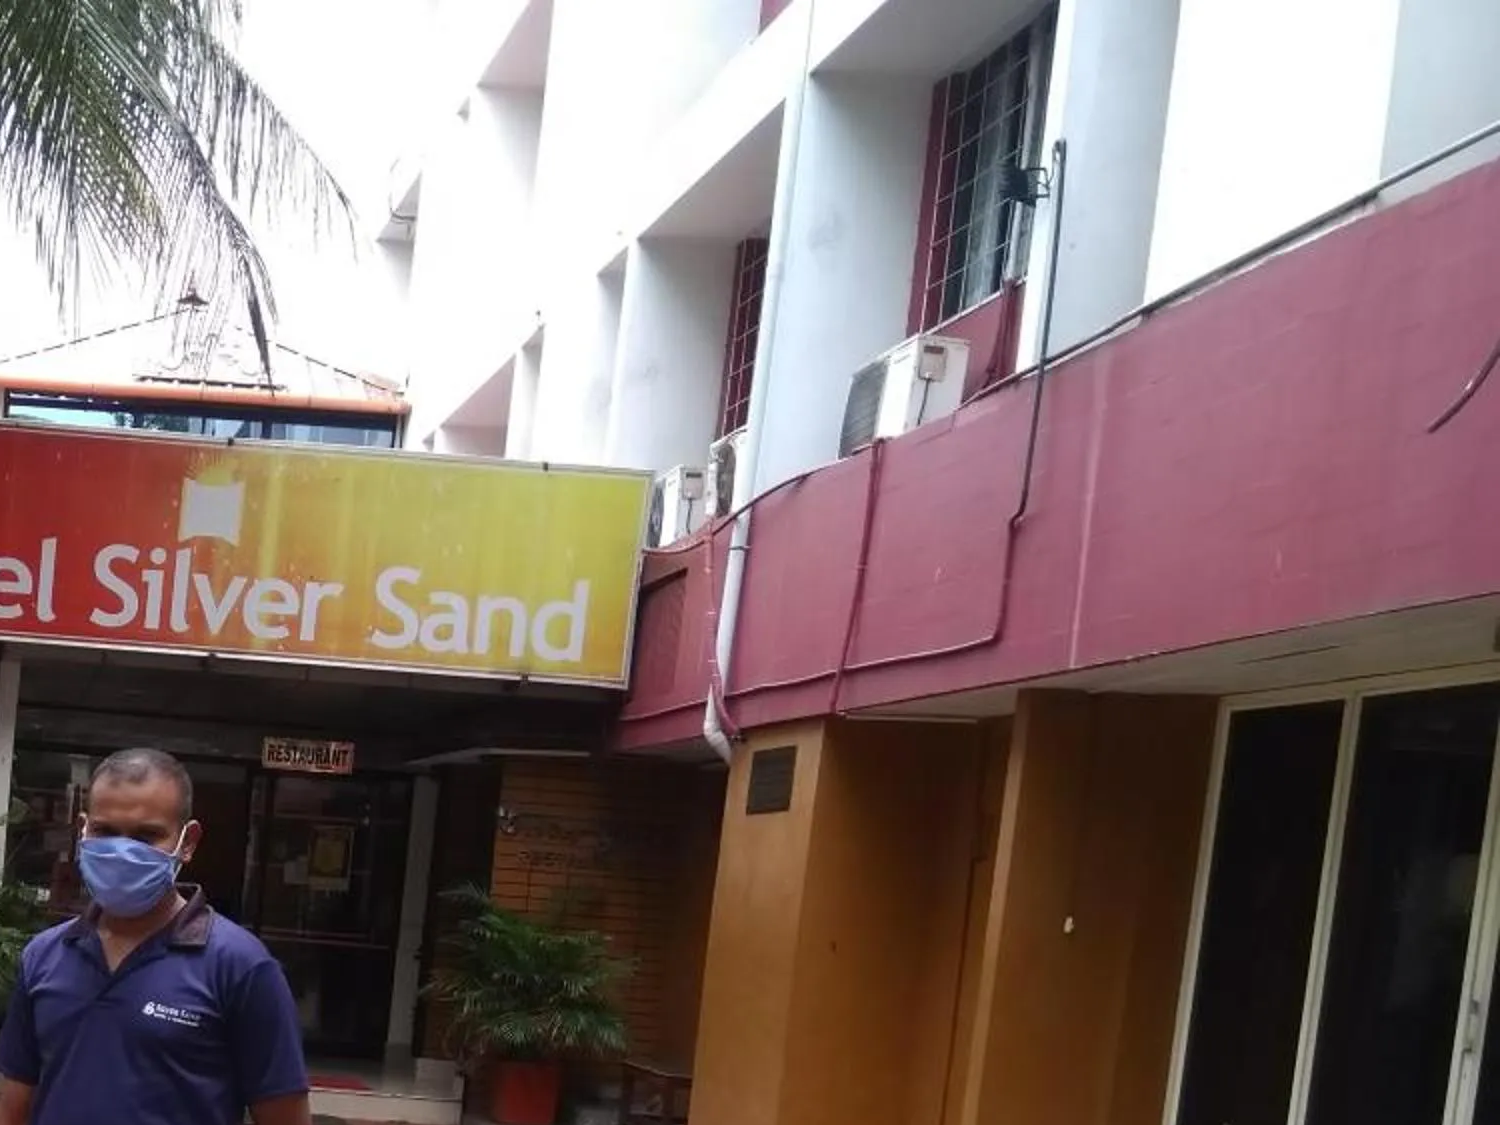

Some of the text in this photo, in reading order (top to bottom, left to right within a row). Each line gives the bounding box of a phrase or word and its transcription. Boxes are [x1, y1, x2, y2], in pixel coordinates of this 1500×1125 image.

[89, 544, 345, 641] Silver
[370, 565, 591, 661] Sand
[267, 744, 349, 768] RESTAURANT
